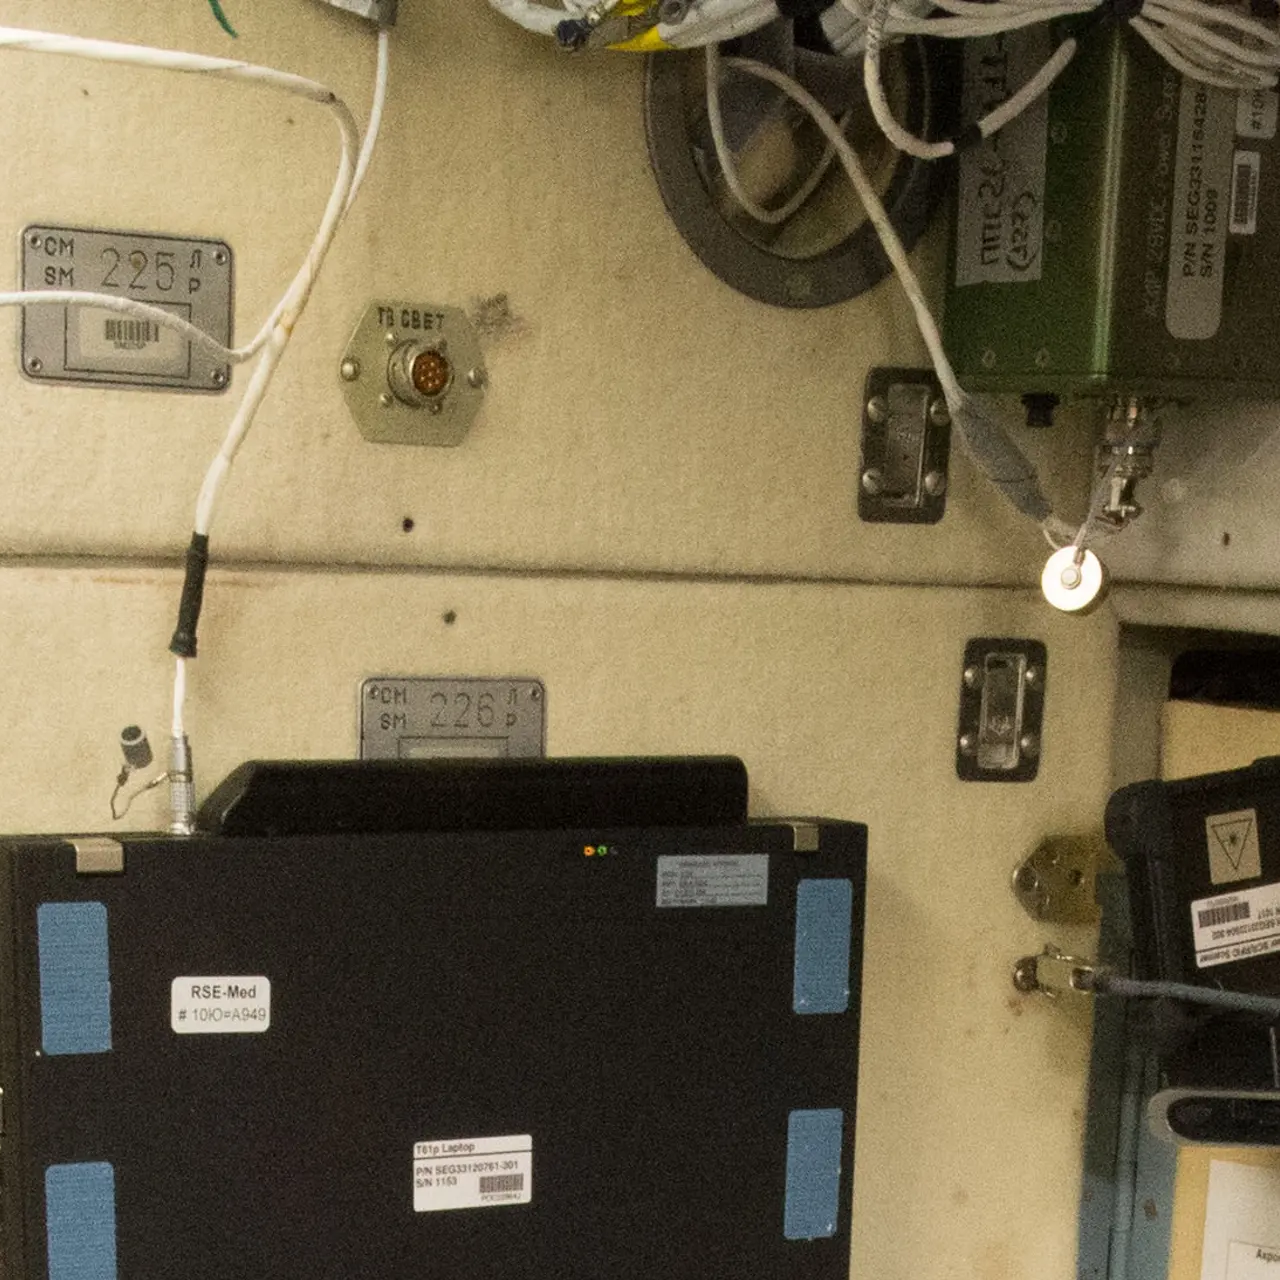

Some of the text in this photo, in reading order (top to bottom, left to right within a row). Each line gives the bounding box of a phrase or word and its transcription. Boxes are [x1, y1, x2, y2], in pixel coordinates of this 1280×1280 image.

[1182, 242, 1197, 278] P/N
[1200, 243, 1214, 278] S/N
[44, 266, 75, 287] SM
[100, 248, 175, 291] 225
[430, 692, 494, 728] 226
[380, 712, 407, 730] SM
[191, 985, 257, 999] RSE-Med
[178, 1008, 187, 1021] #
[442, 1143, 475, 1154] Laptop
[416, 1166, 433, 1176] P/N
[416, 1178, 433, 1188] S/N
